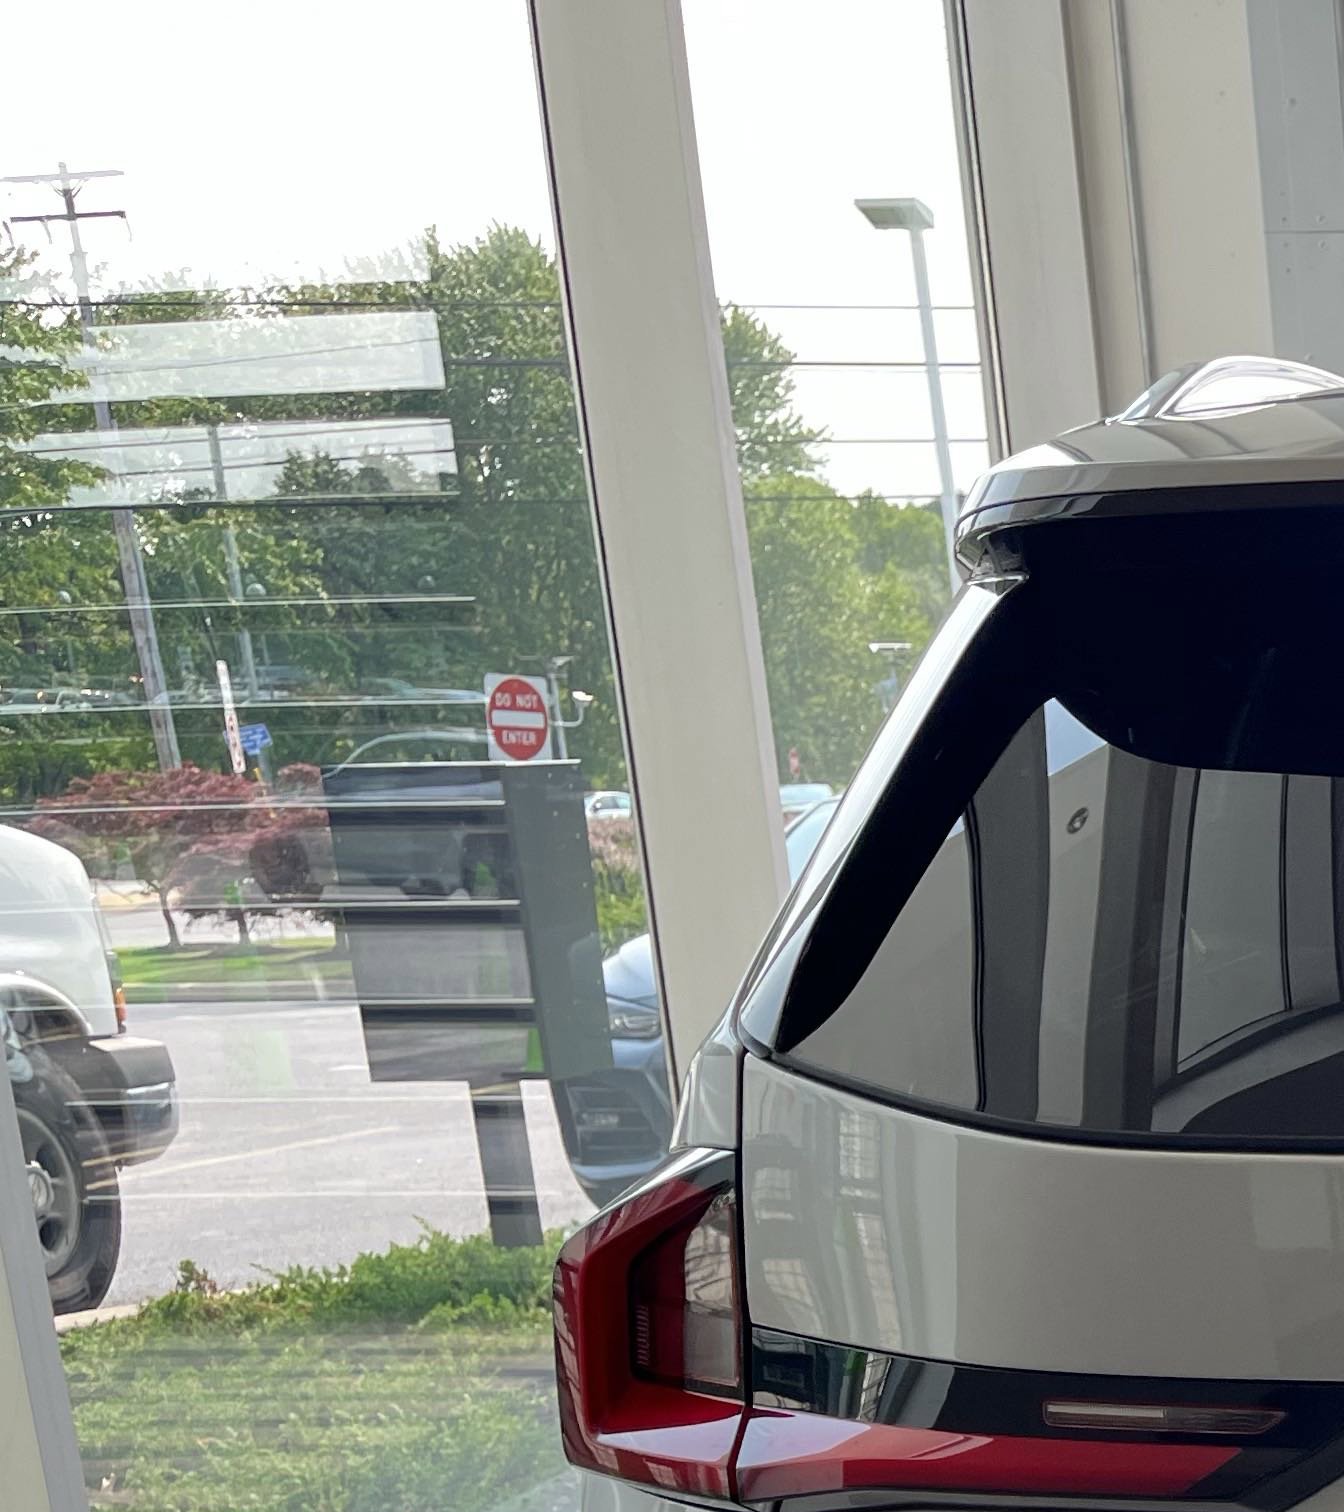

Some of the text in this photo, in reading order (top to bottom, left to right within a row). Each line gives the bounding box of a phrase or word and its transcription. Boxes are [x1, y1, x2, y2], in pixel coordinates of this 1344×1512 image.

[495, 692, 537, 709] DO NOT
[502, 730, 536, 745] ENTER
